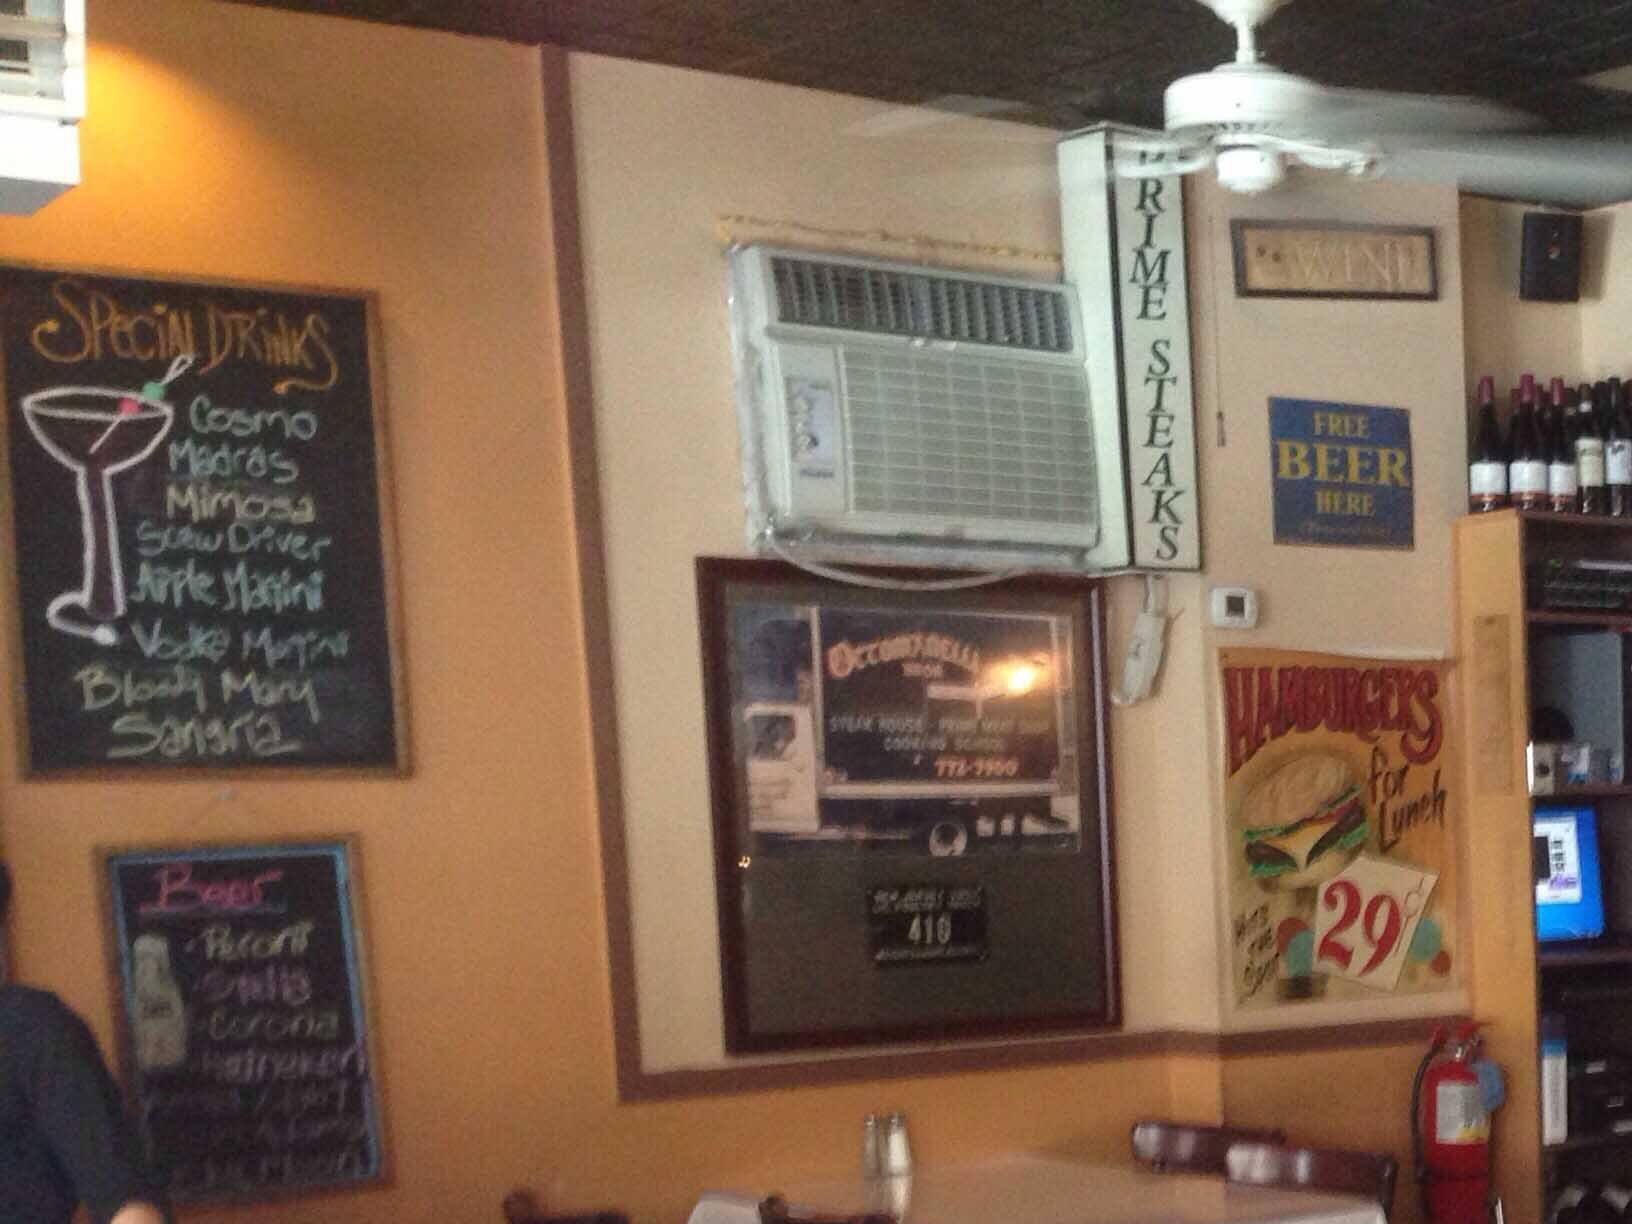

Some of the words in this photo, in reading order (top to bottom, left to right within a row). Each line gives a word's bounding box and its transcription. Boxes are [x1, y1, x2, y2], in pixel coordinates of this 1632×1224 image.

[190, 394, 318, 440] Cosmo
[1312, 410, 1369, 438] FREE
[1142, 340, 1186, 561] STEAKS
[1276, 439, 1409, 488] BEER
[165, 485, 316, 524] Mimosa
[1315, 489, 1376, 516] HERE
